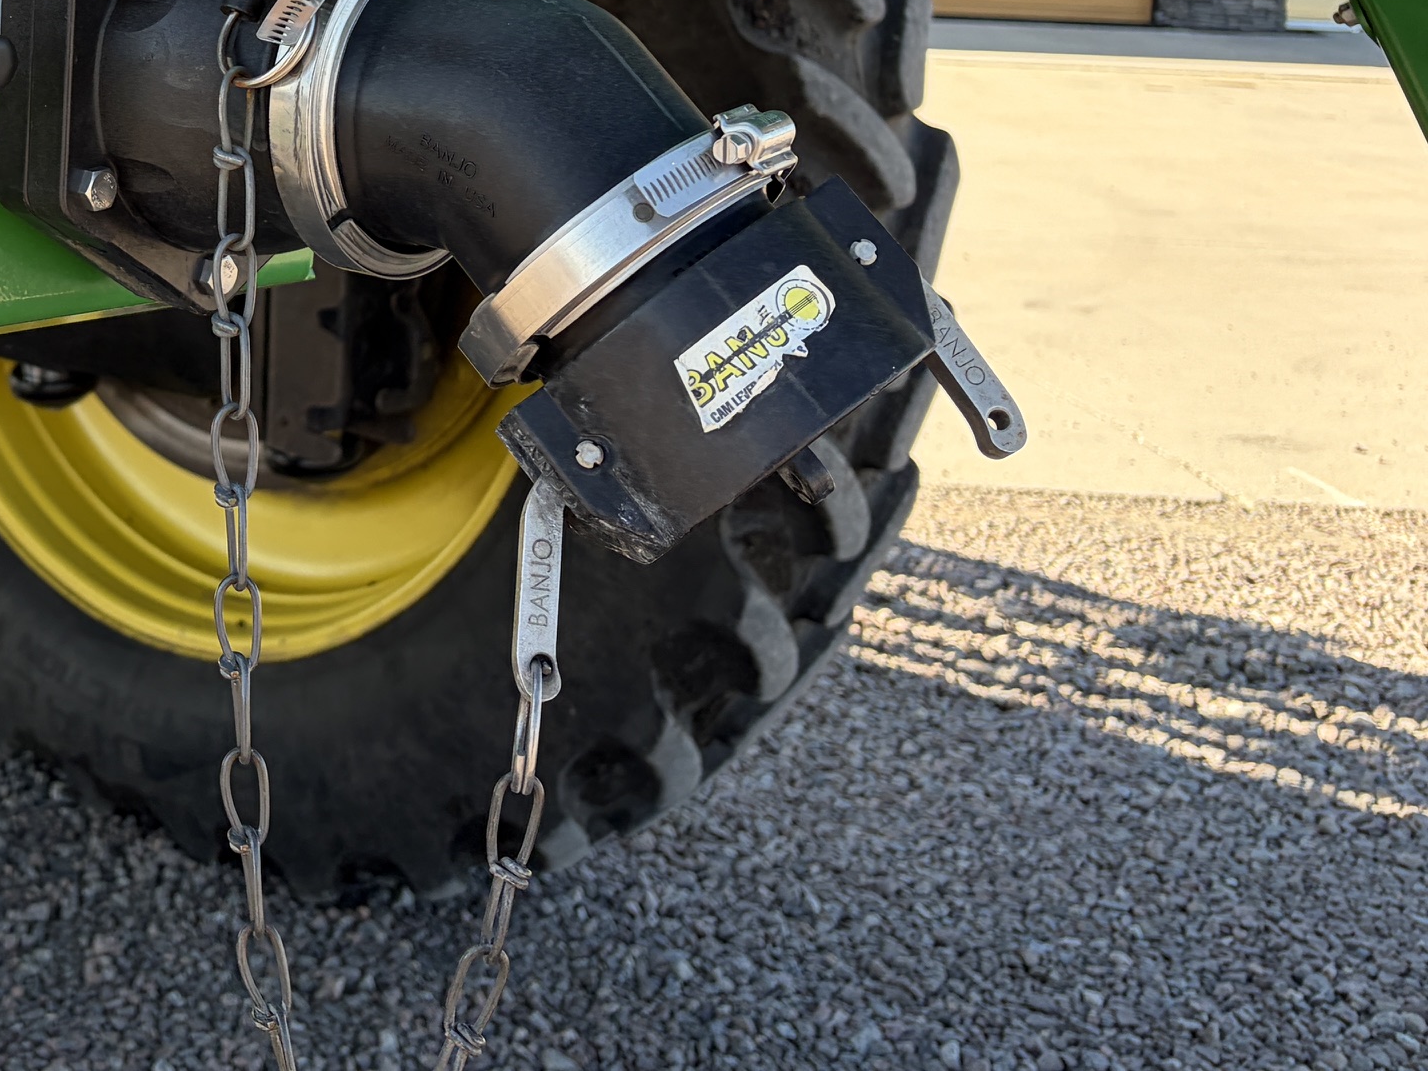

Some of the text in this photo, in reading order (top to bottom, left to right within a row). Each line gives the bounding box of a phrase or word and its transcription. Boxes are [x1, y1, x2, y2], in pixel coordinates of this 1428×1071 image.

[419, 132, 477, 179] BANJO
[464, 186, 496, 218] USA
[931, 307, 985, 386] BANJO
[710, 401, 735, 423] CAM
[527, 538, 553, 627] BANJO
